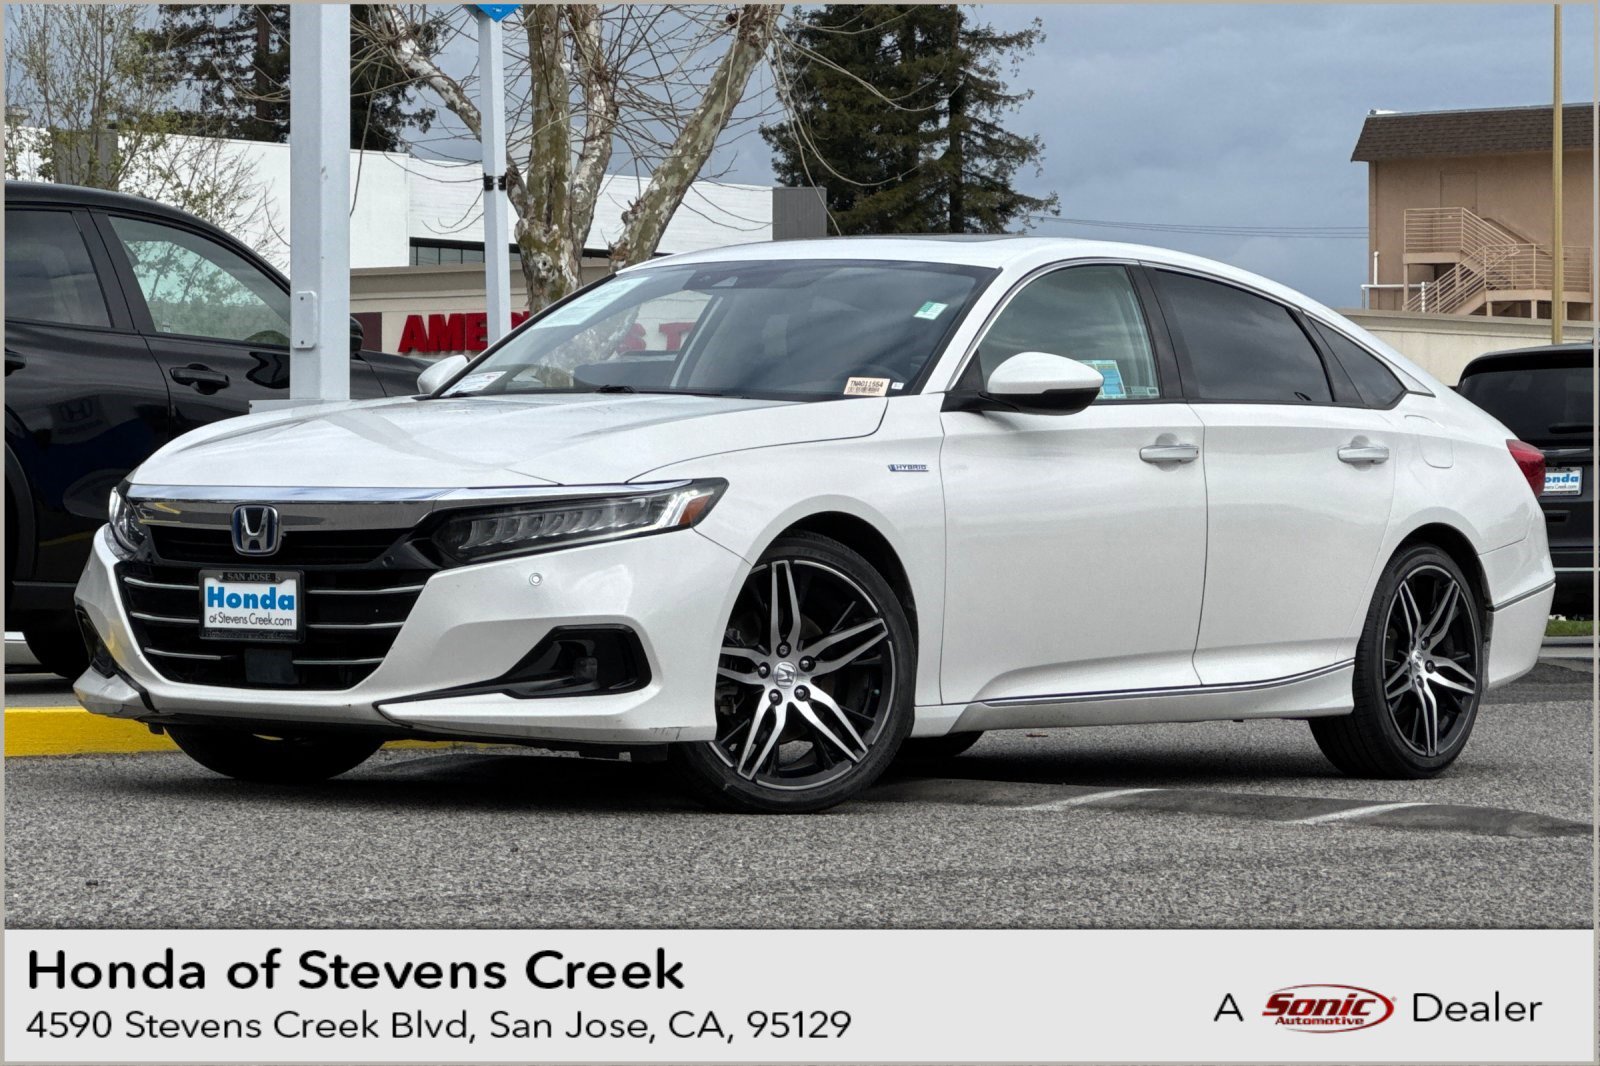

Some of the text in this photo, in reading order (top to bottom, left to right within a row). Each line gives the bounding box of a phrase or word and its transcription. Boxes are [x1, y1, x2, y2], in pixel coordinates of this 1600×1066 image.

[1544, 474, 1579, 483] onda
[227, 572, 272, 581] SAN JOSE
[207, 586, 294, 610] Honda
[209, 612, 292, 626] of Stevens Creek.com
